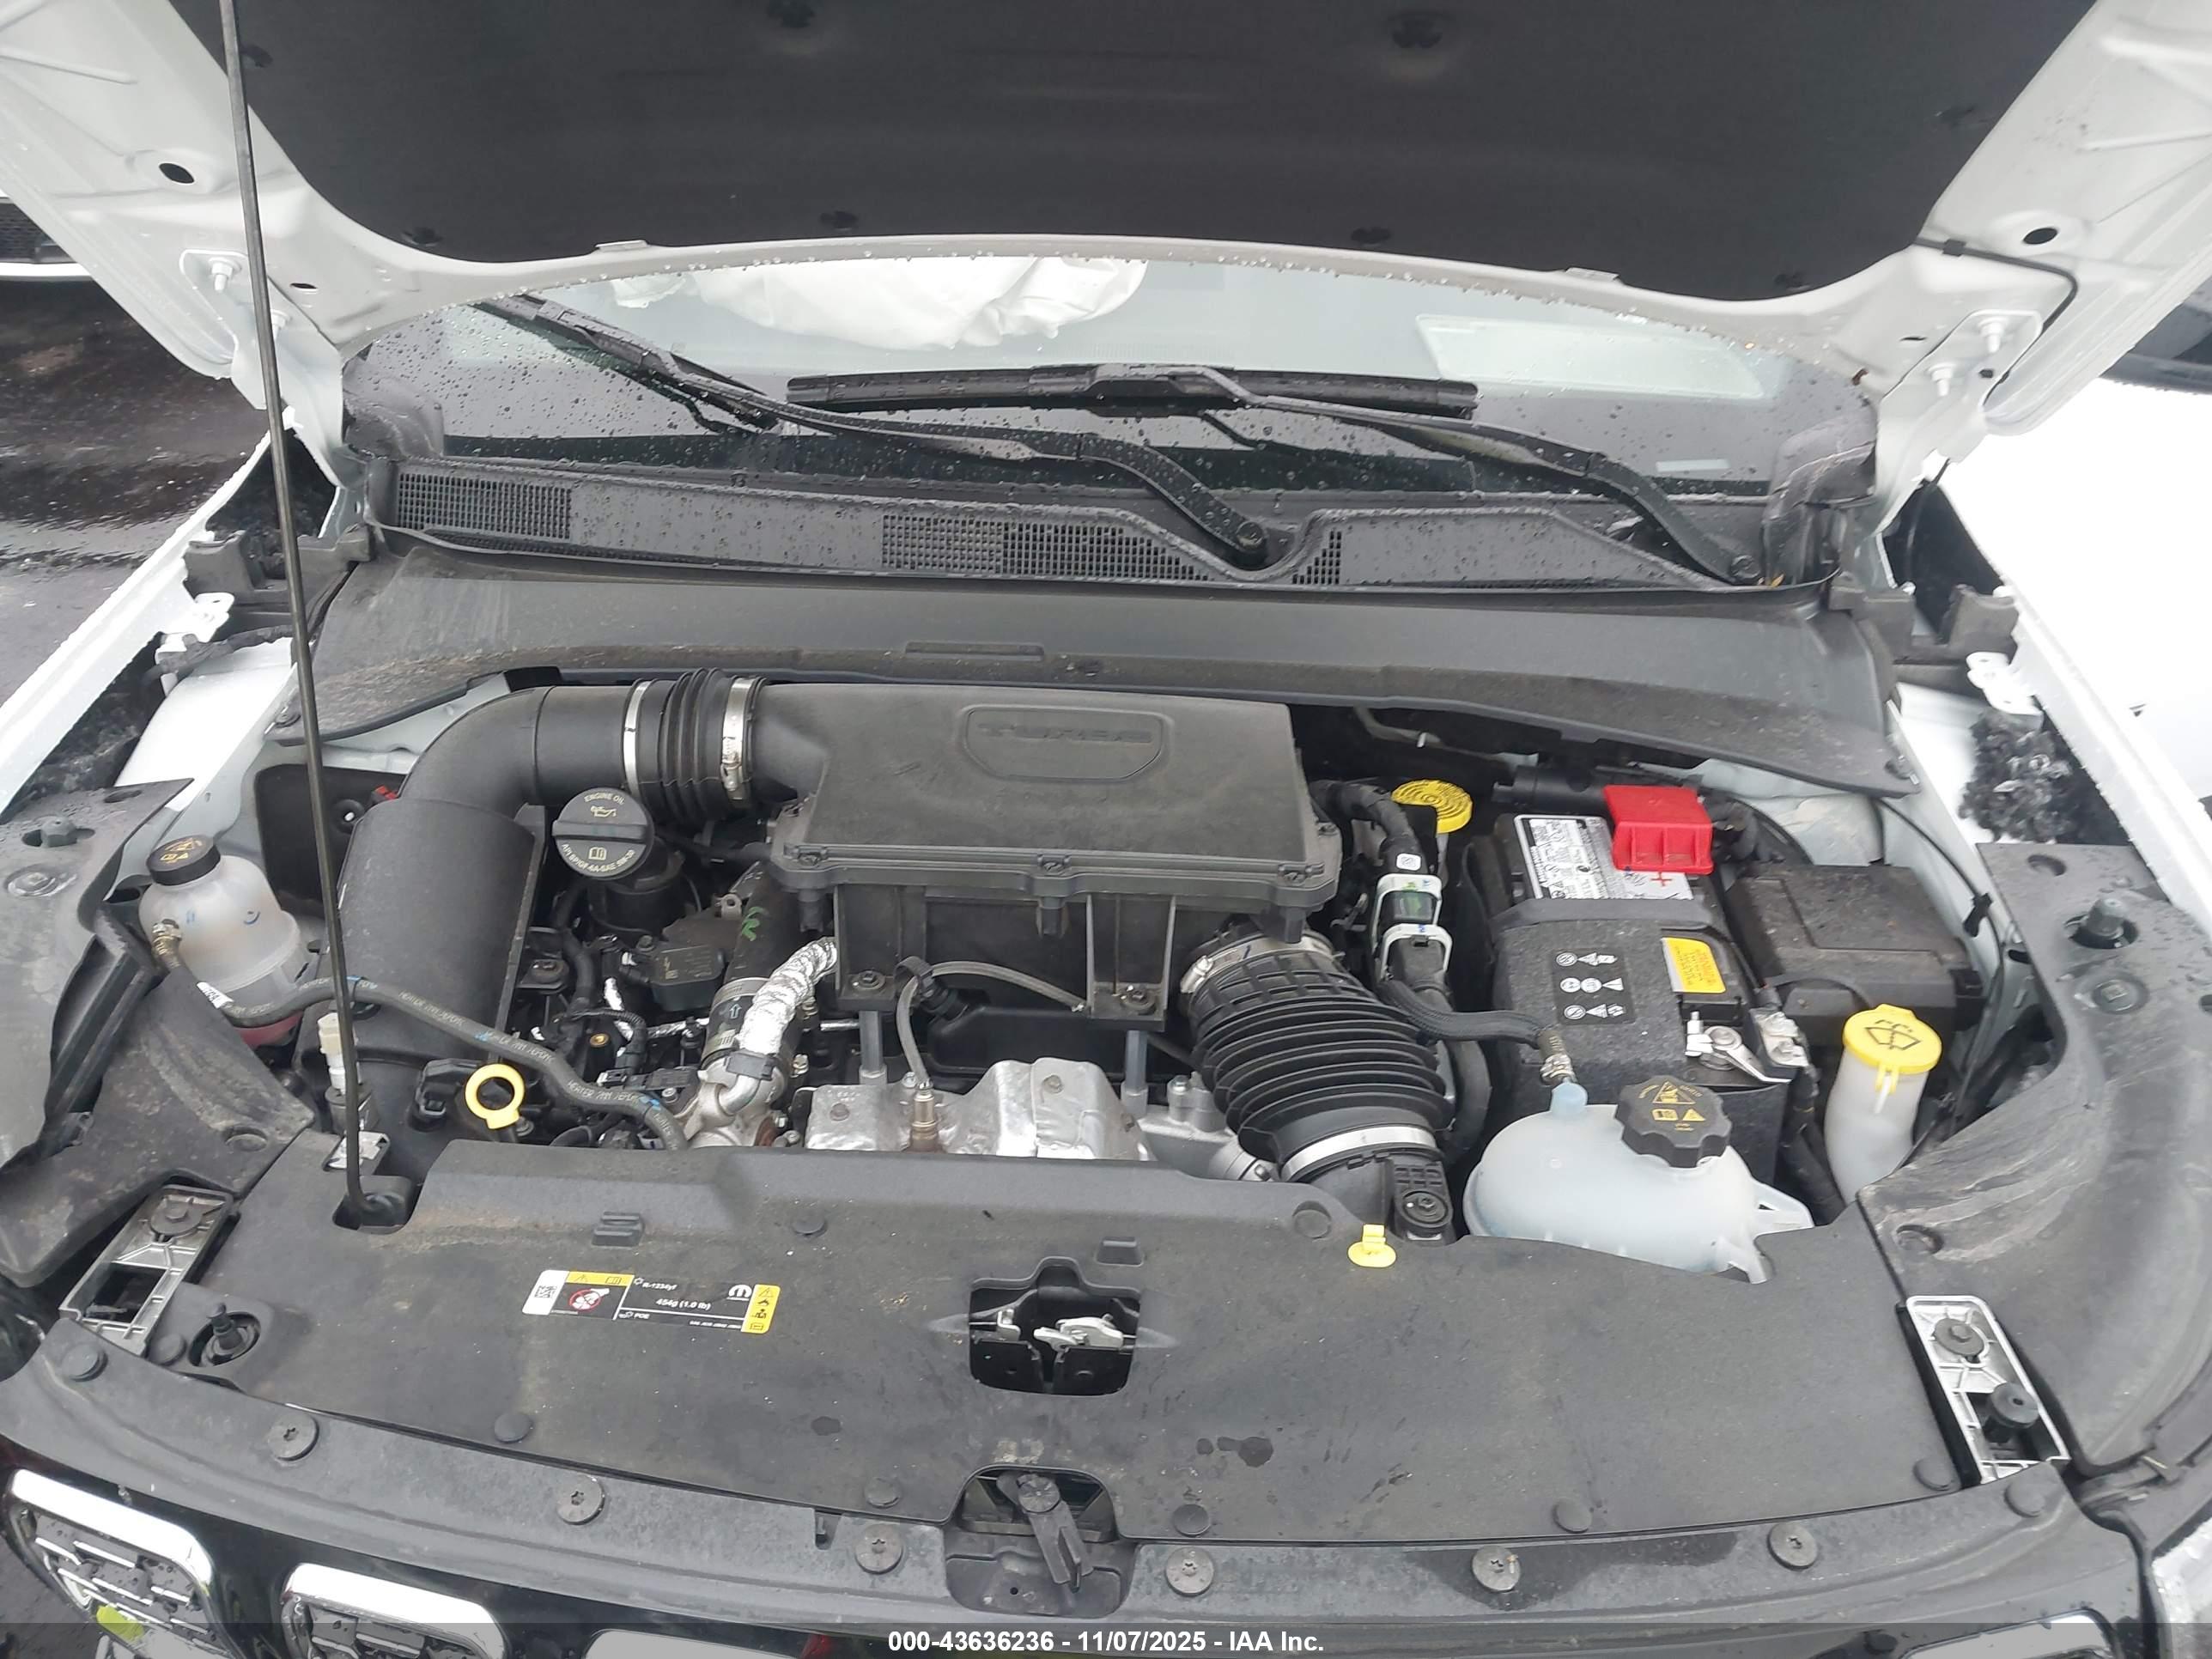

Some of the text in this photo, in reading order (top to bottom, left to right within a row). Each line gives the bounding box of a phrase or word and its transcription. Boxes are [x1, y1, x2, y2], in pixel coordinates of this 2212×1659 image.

[584, 792, 625, 805] ENGINE OIL
[655, 1298, 678, 1308] 454g
[678, 1300, 697, 1309] (1.0
